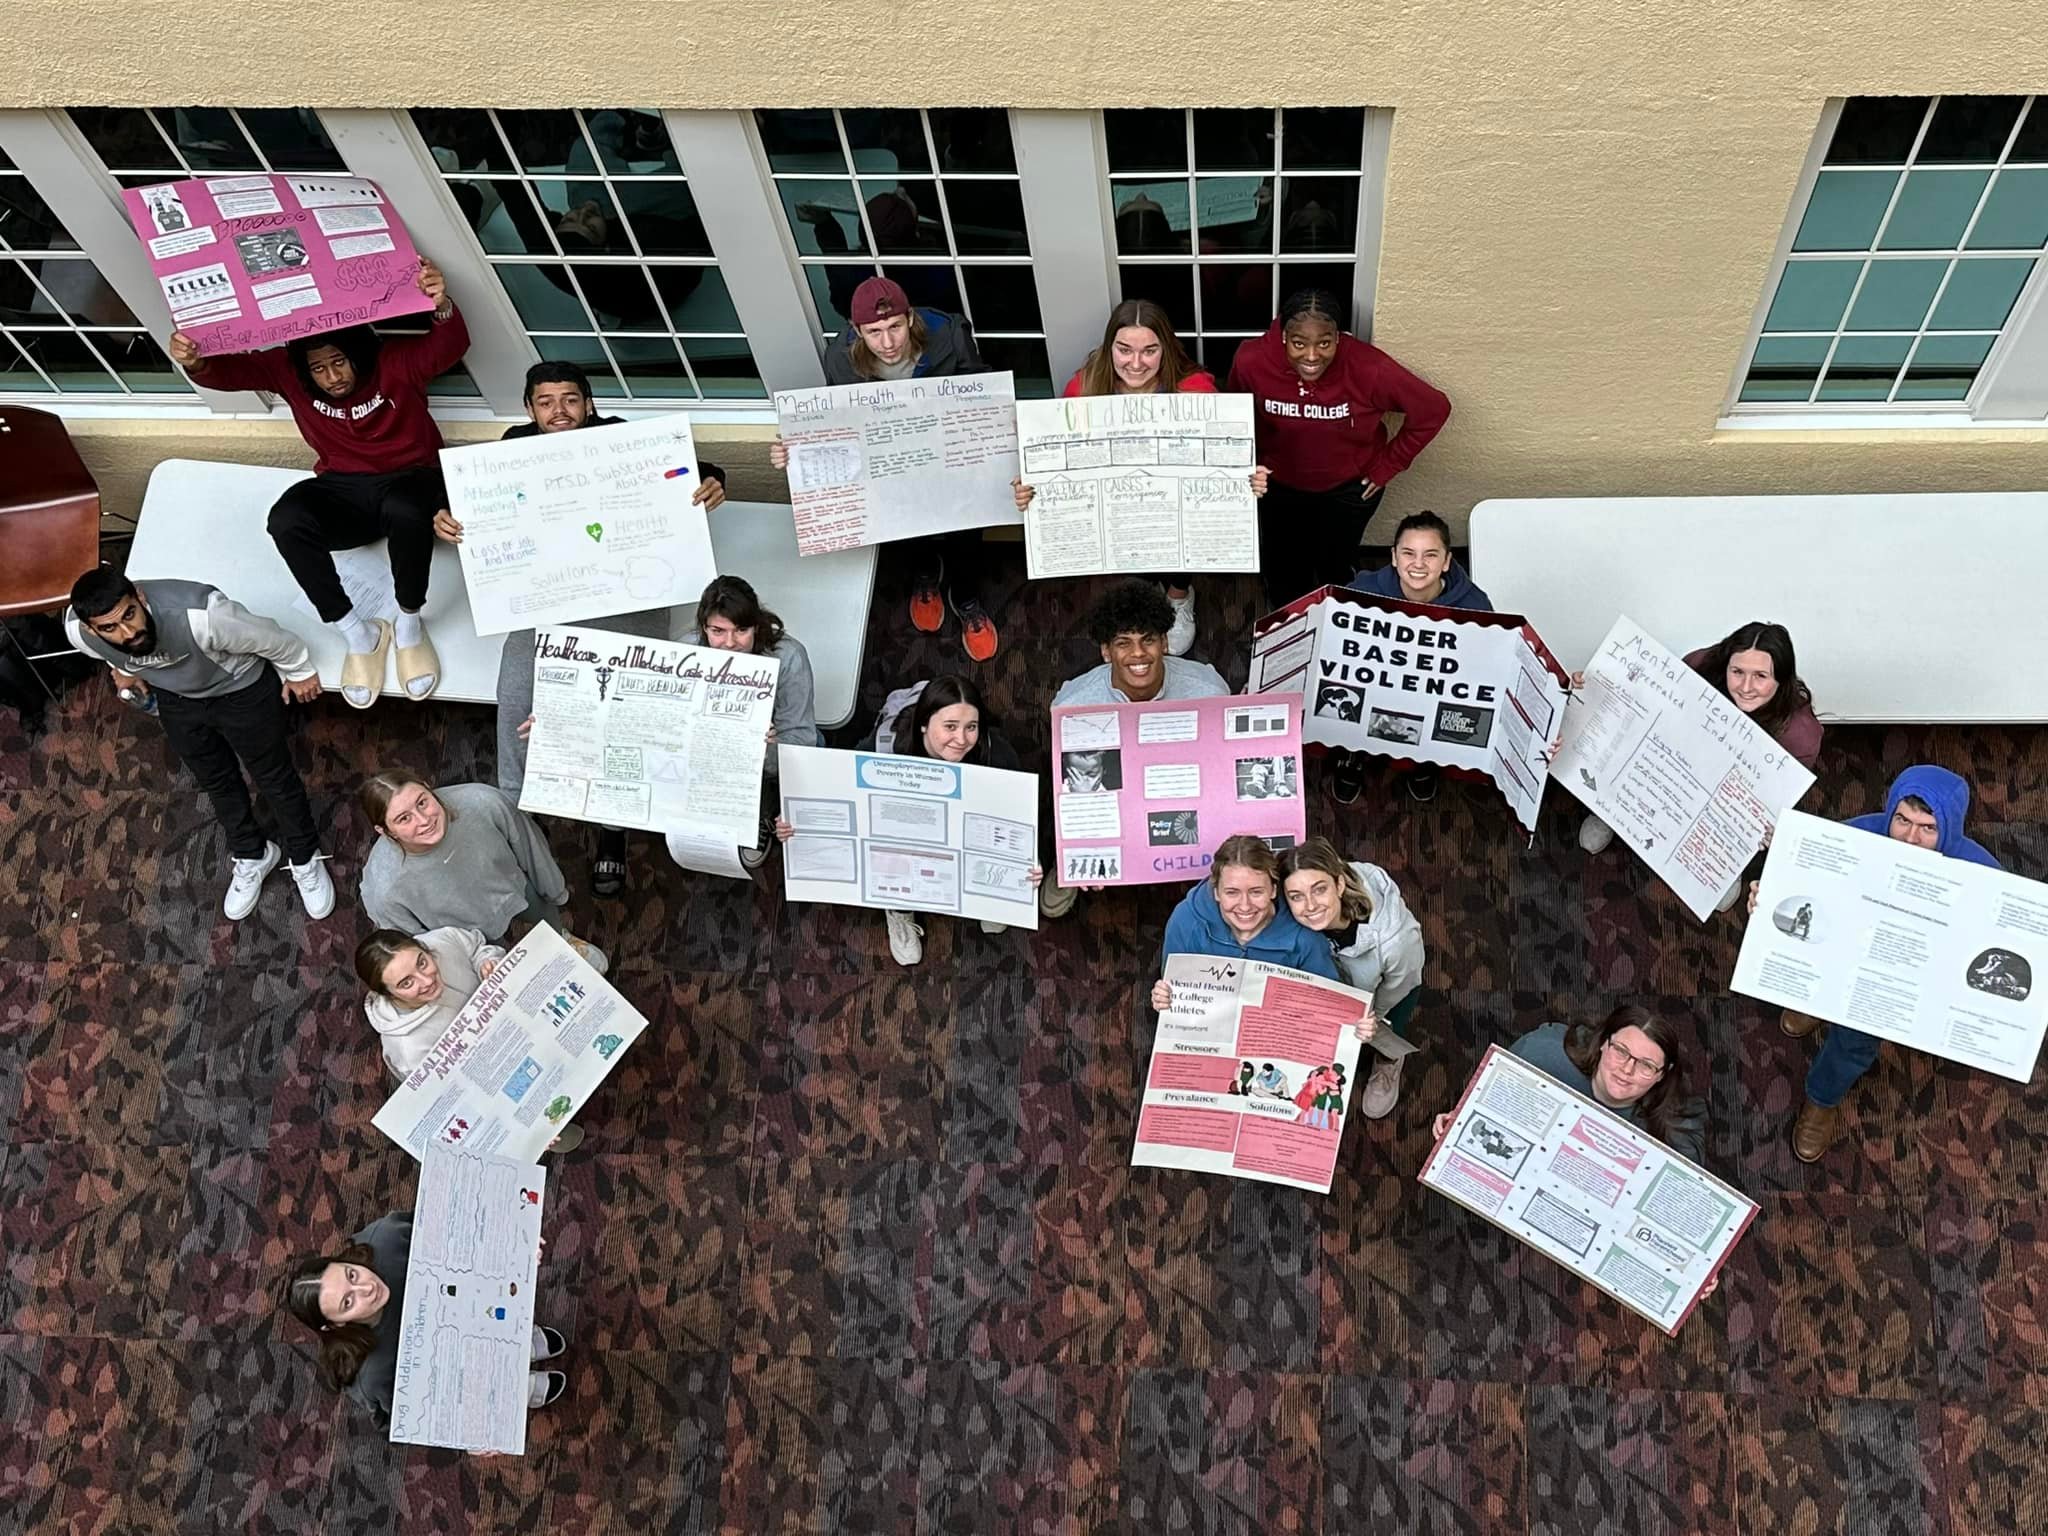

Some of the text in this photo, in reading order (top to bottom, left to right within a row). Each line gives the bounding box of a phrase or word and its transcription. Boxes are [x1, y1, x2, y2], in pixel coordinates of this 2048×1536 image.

[776, 379, 984, 417] Mental Health in Schools
[1169, 395, 1219, 421] NEGLECT
[1264, 399, 1350, 419] BETHEL COLLEGE
[1331, 611, 1458, 650] GENDER
[535, 633, 602, 664] Healthcare
[608, 646, 631, 668] and
[1341, 639, 1459, 675] BASED
[1319, 659, 1496, 702] VIOLENCE
[1625, 635, 1687, 684] Mental
[1698, 687, 1754, 745] Health
[1153, 853, 1212, 871] CHILD
[1179, 992, 1214, 1004] College
[1203, 982, 1236, 993] Health
[406, 1012, 473, 1091] HEALTHCARE
[392, 1403, 410, 1439] Drug
